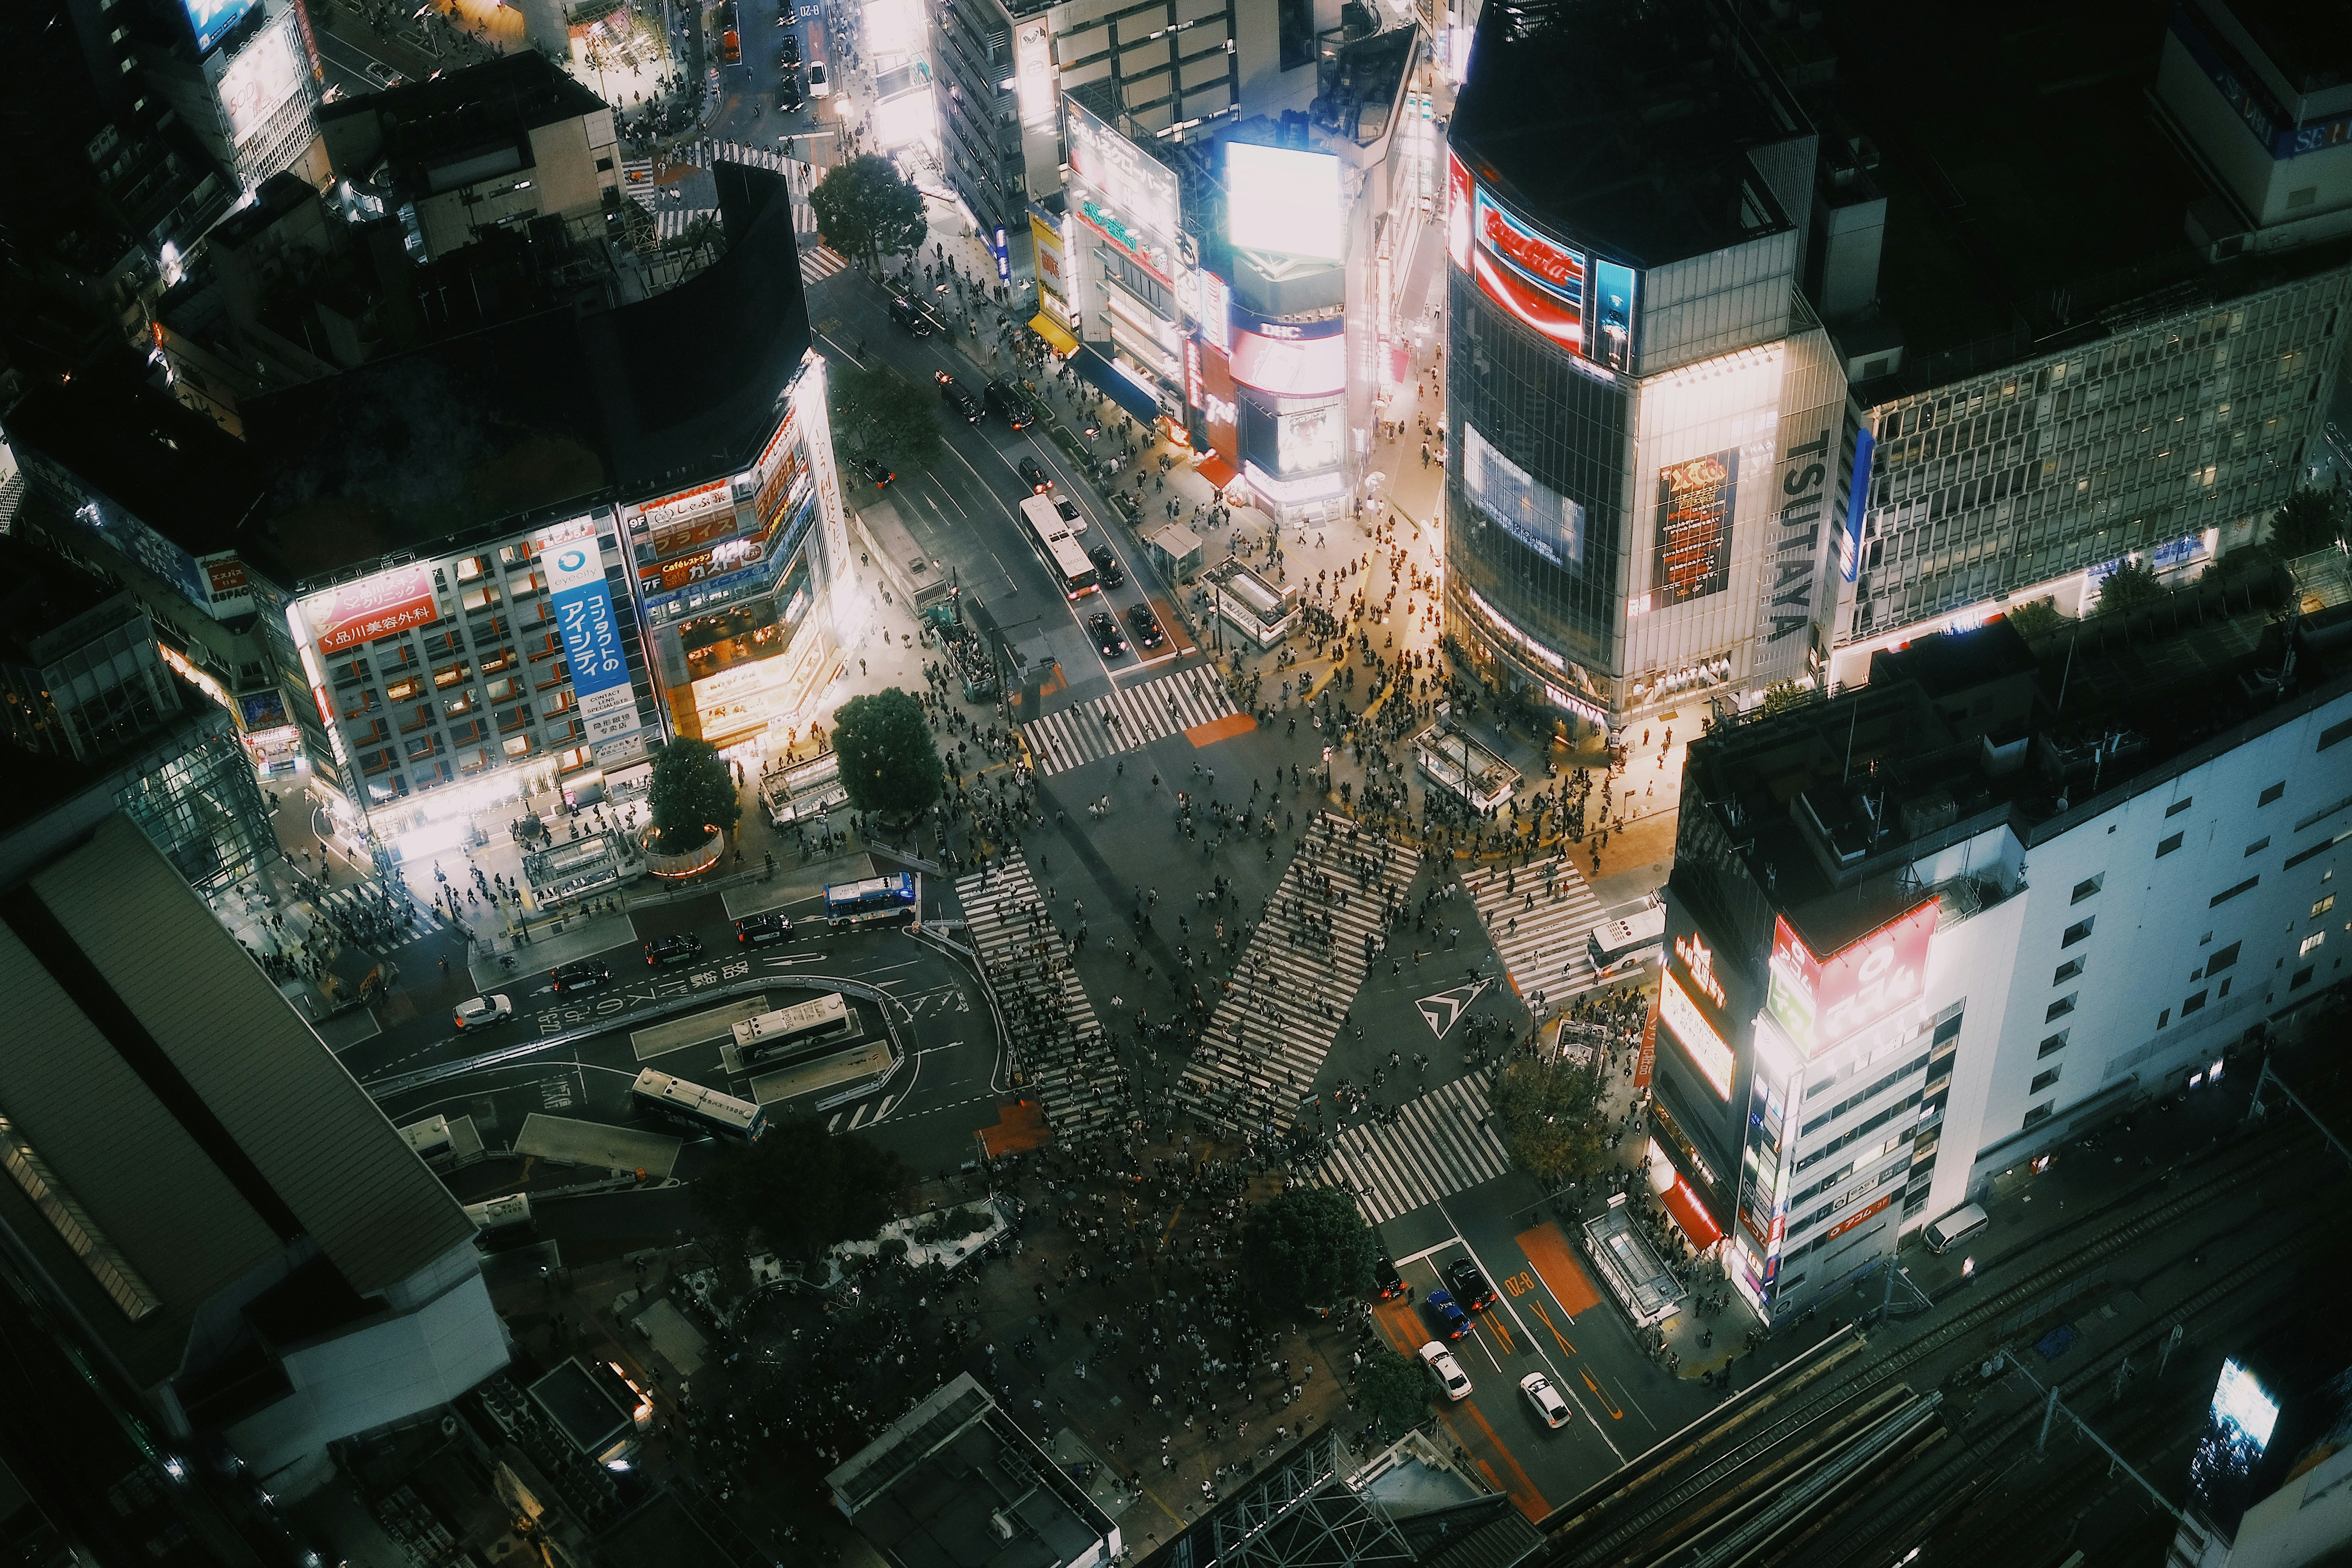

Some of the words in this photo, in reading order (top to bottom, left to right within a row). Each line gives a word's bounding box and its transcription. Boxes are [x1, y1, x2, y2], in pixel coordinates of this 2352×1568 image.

[1068, 115, 1172, 204] ももいろクローバーZ
[1260, 323, 1301, 338] DHC
[677, 491, 726, 514] しゃぶ葉
[629, 516, 646, 528] 9F
[1768, 429, 1830, 643] TSUTAYA
[212, 569, 244, 581] エスパス
[359, 573, 420, 599] 品川スキン
[555, 568, 597, 586] eyecity
[643, 579, 660, 592] 7F
[362, 585, 416, 609] クリニック
[335, 605, 430, 645] 品川美容外科
[587, 595, 620, 672] コンタクトの
[561, 600, 598, 676] アイシティ
[1656, 657, 1731, 688] TSUTAYA
[587, 697, 628, 714] SPECIALISTS
[590, 689, 620, 702] CONTACT
[598, 697, 615, 705] LENS
[1544, 683, 1608, 726] TSUTAYA
[564, 959, 750, 1024] 路線バスのみ
[1825, 965, 1916, 1037] アコム
[1845, 1208, 1872, 1228] アコム
[1504, 1271, 1535, 1298] 8-20
